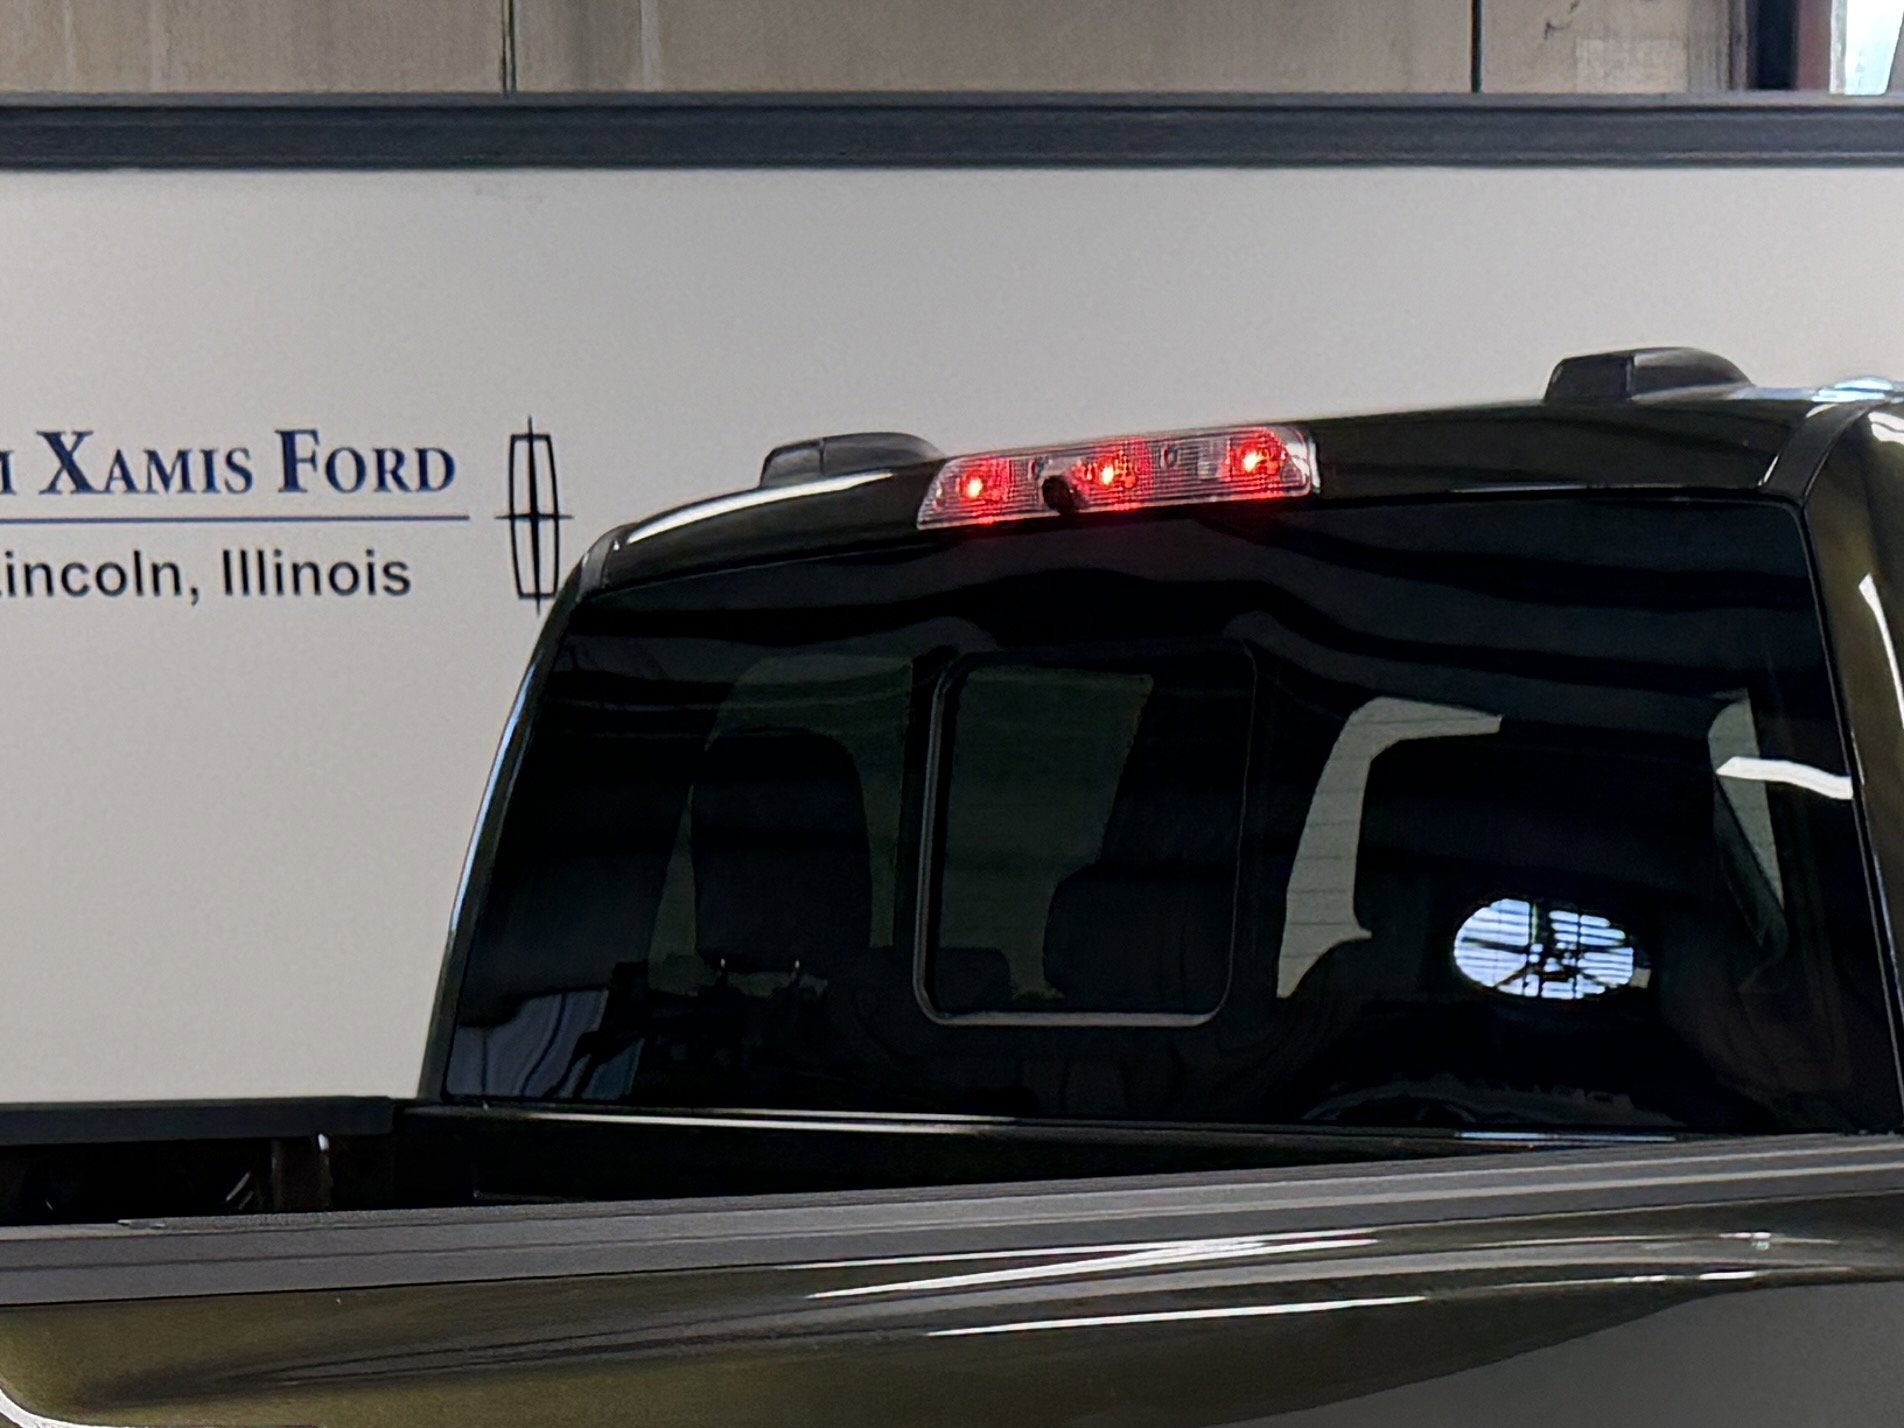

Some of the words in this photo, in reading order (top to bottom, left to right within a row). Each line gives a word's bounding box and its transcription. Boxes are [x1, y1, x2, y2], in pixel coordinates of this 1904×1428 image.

[35, 429, 254, 498] XAMIS
[274, 428, 458, 494] FORD
[220, 548, 411, 597] Illinois
